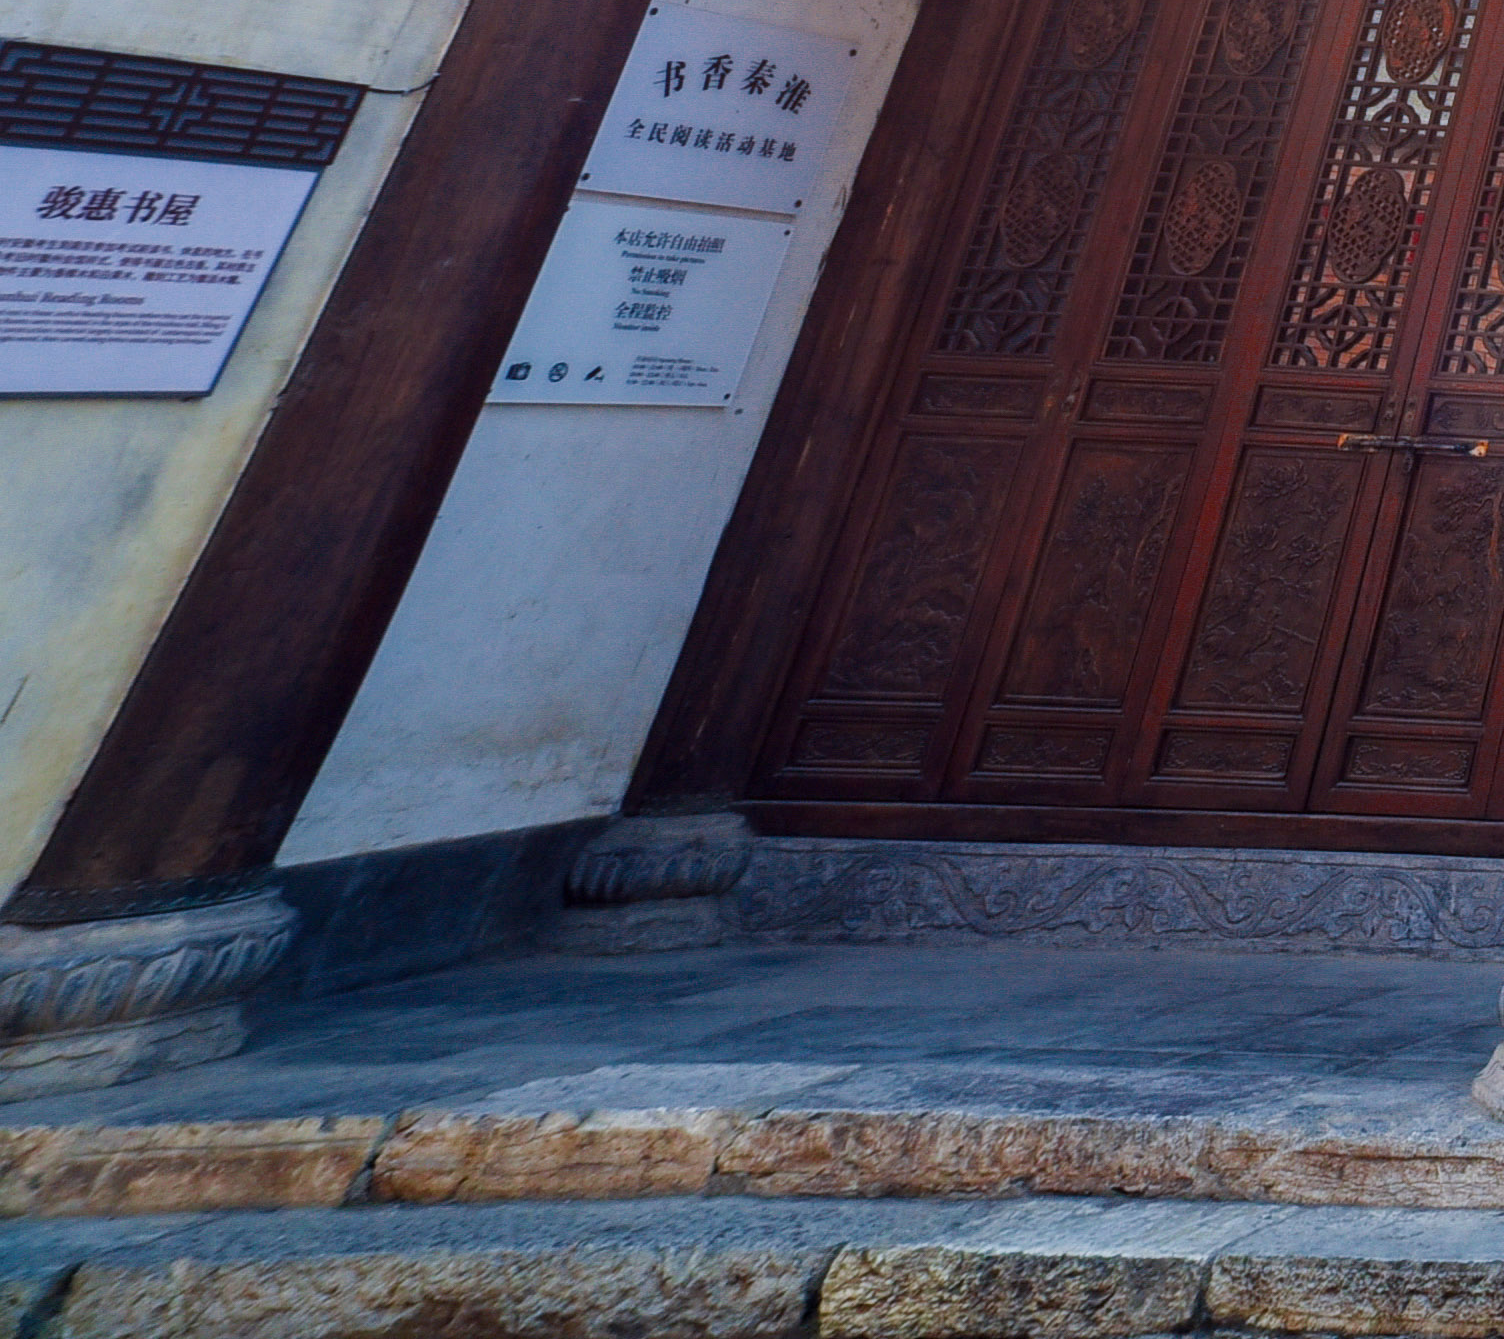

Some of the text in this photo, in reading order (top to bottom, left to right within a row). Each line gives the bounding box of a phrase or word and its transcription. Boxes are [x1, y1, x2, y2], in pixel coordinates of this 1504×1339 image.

[653, 54, 812, 115] 书香秦淮
[624, 118, 798, 162] 全民阅读活动基地
[36, 185, 202, 226] 骏惠书屋
[614, 228, 726, 254] 本店允许自由拍照
[627, 266, 688, 286] 禁止吸烟
